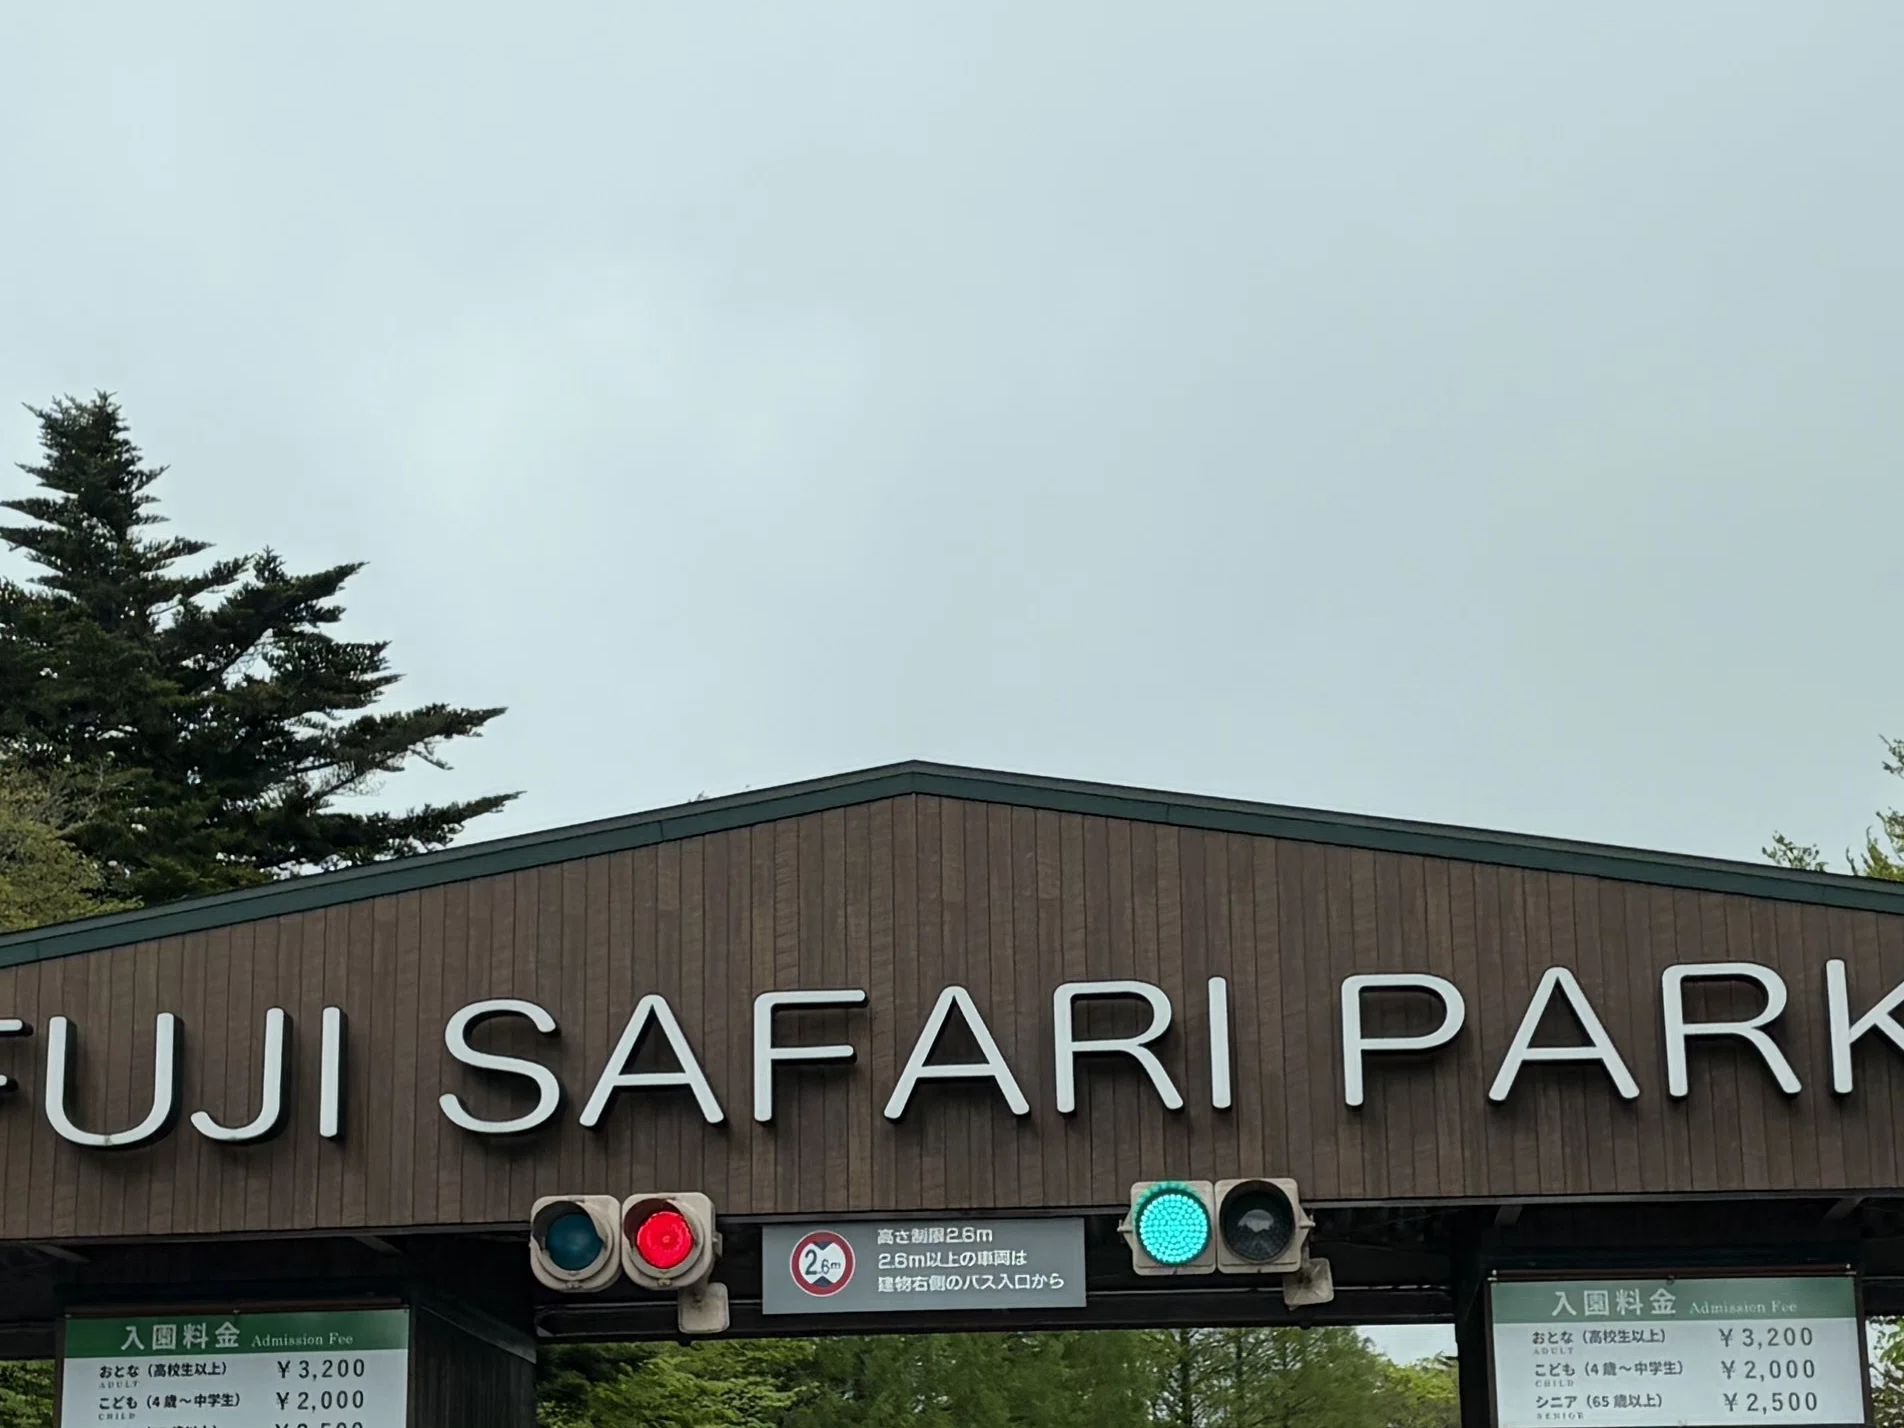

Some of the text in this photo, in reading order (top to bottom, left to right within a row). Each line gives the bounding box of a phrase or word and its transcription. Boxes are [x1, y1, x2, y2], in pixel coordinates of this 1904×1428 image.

[438, 976, 1232, 1135] SAFARI
[1551, 1288, 1677, 1317] 入園料金
[121, 1321, 241, 1351] 入園料金
[328, 1332, 354, 1346] Fee
